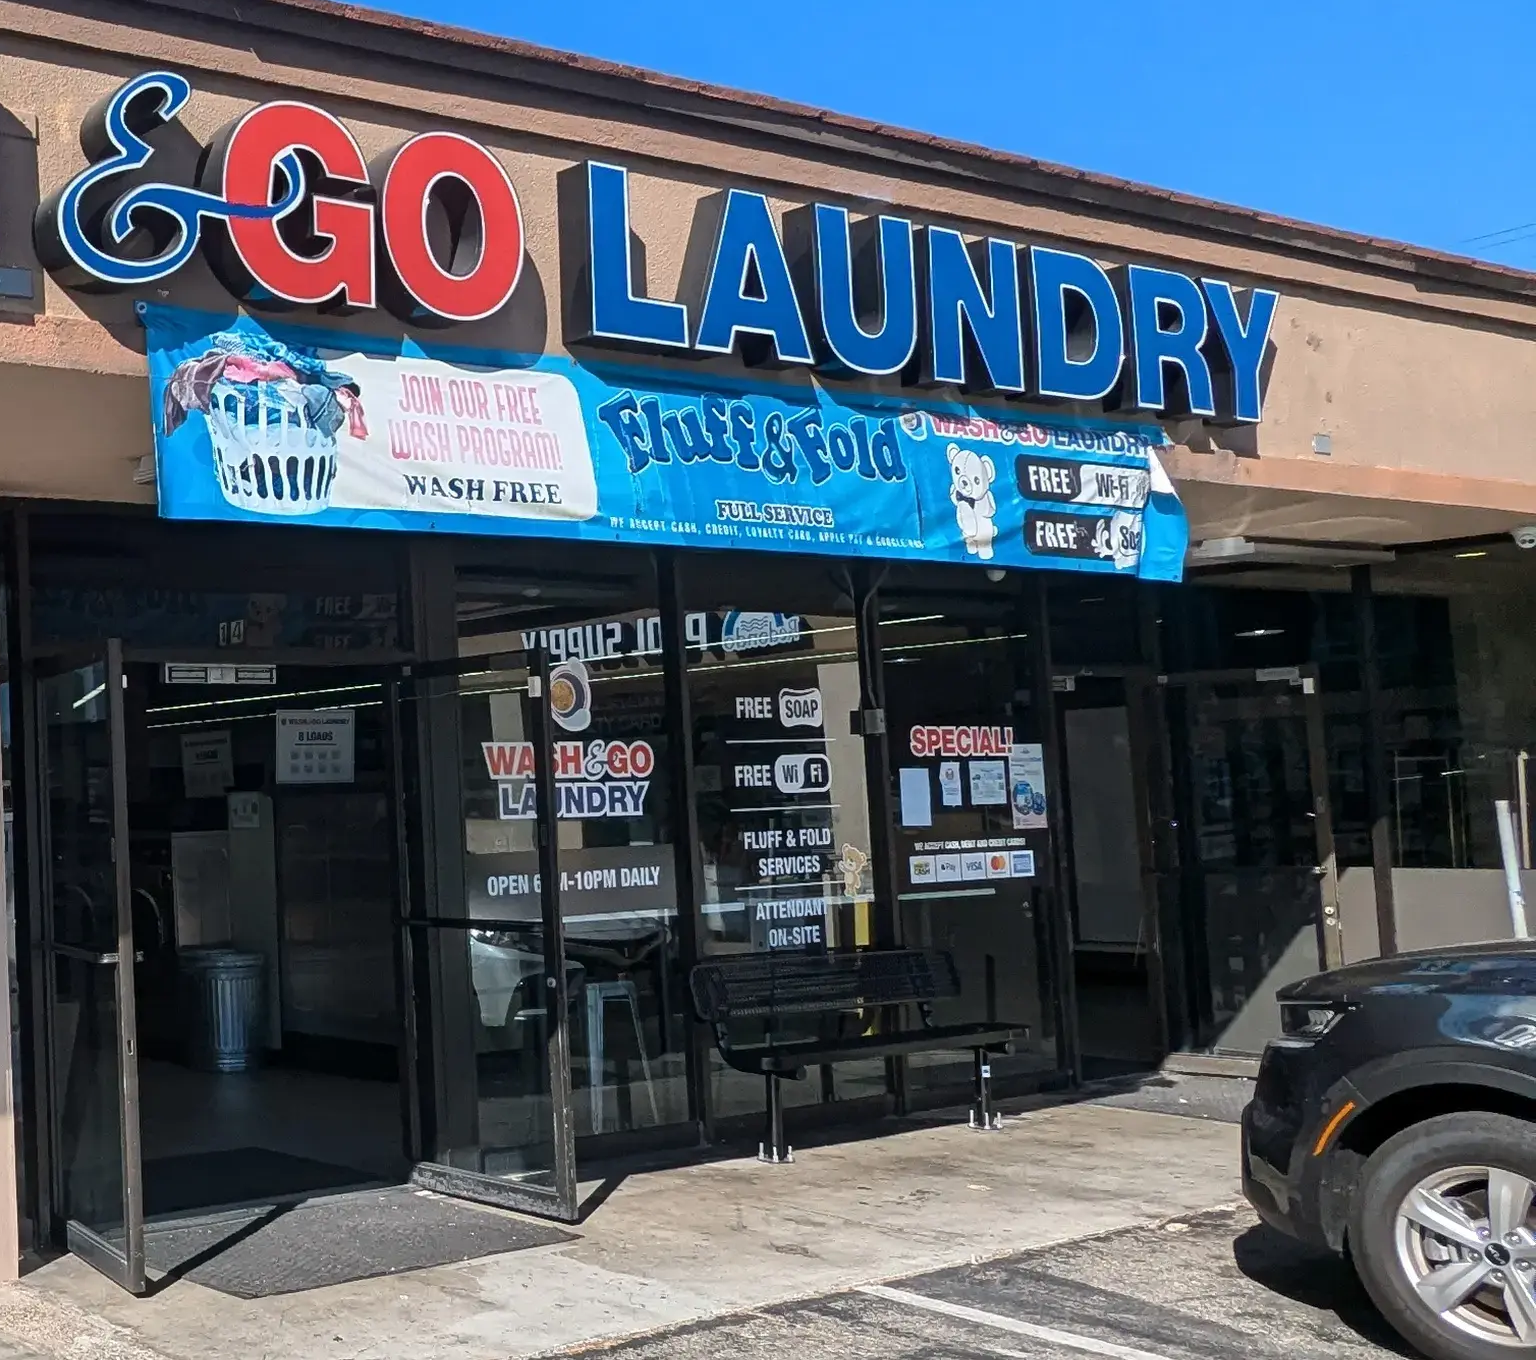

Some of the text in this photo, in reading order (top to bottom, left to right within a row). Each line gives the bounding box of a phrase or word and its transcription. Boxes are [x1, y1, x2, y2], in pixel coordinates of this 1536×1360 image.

[223, 100, 525, 321] GO
[586, 160, 1279, 425] LAUNDRY
[399, 374, 542, 425] JOIN OUR FREE
[389, 419, 564, 470] WASH PROGRAM!
[403, 474, 562, 504] WASH FREE
[1028, 465, 1072, 495] FREE
[716, 501, 834, 527] FULL SERVICE
[1035, 521, 1078, 549] FREE
[736, 697, 818, 719] FREE SOAP
[910, 725, 1013, 757] SPECIAL!
[734, 764, 772, 787] FREE
[744, 828, 830, 849] FLUFF & FOLD
[758, 855, 820, 876] SERVICES
[487, 875, 529, 897] OPEN
[621, 866, 661, 888] DAILY
[756, 899, 828, 920] ATTENDANT
[769, 925, 821, 947] ON-SITE
